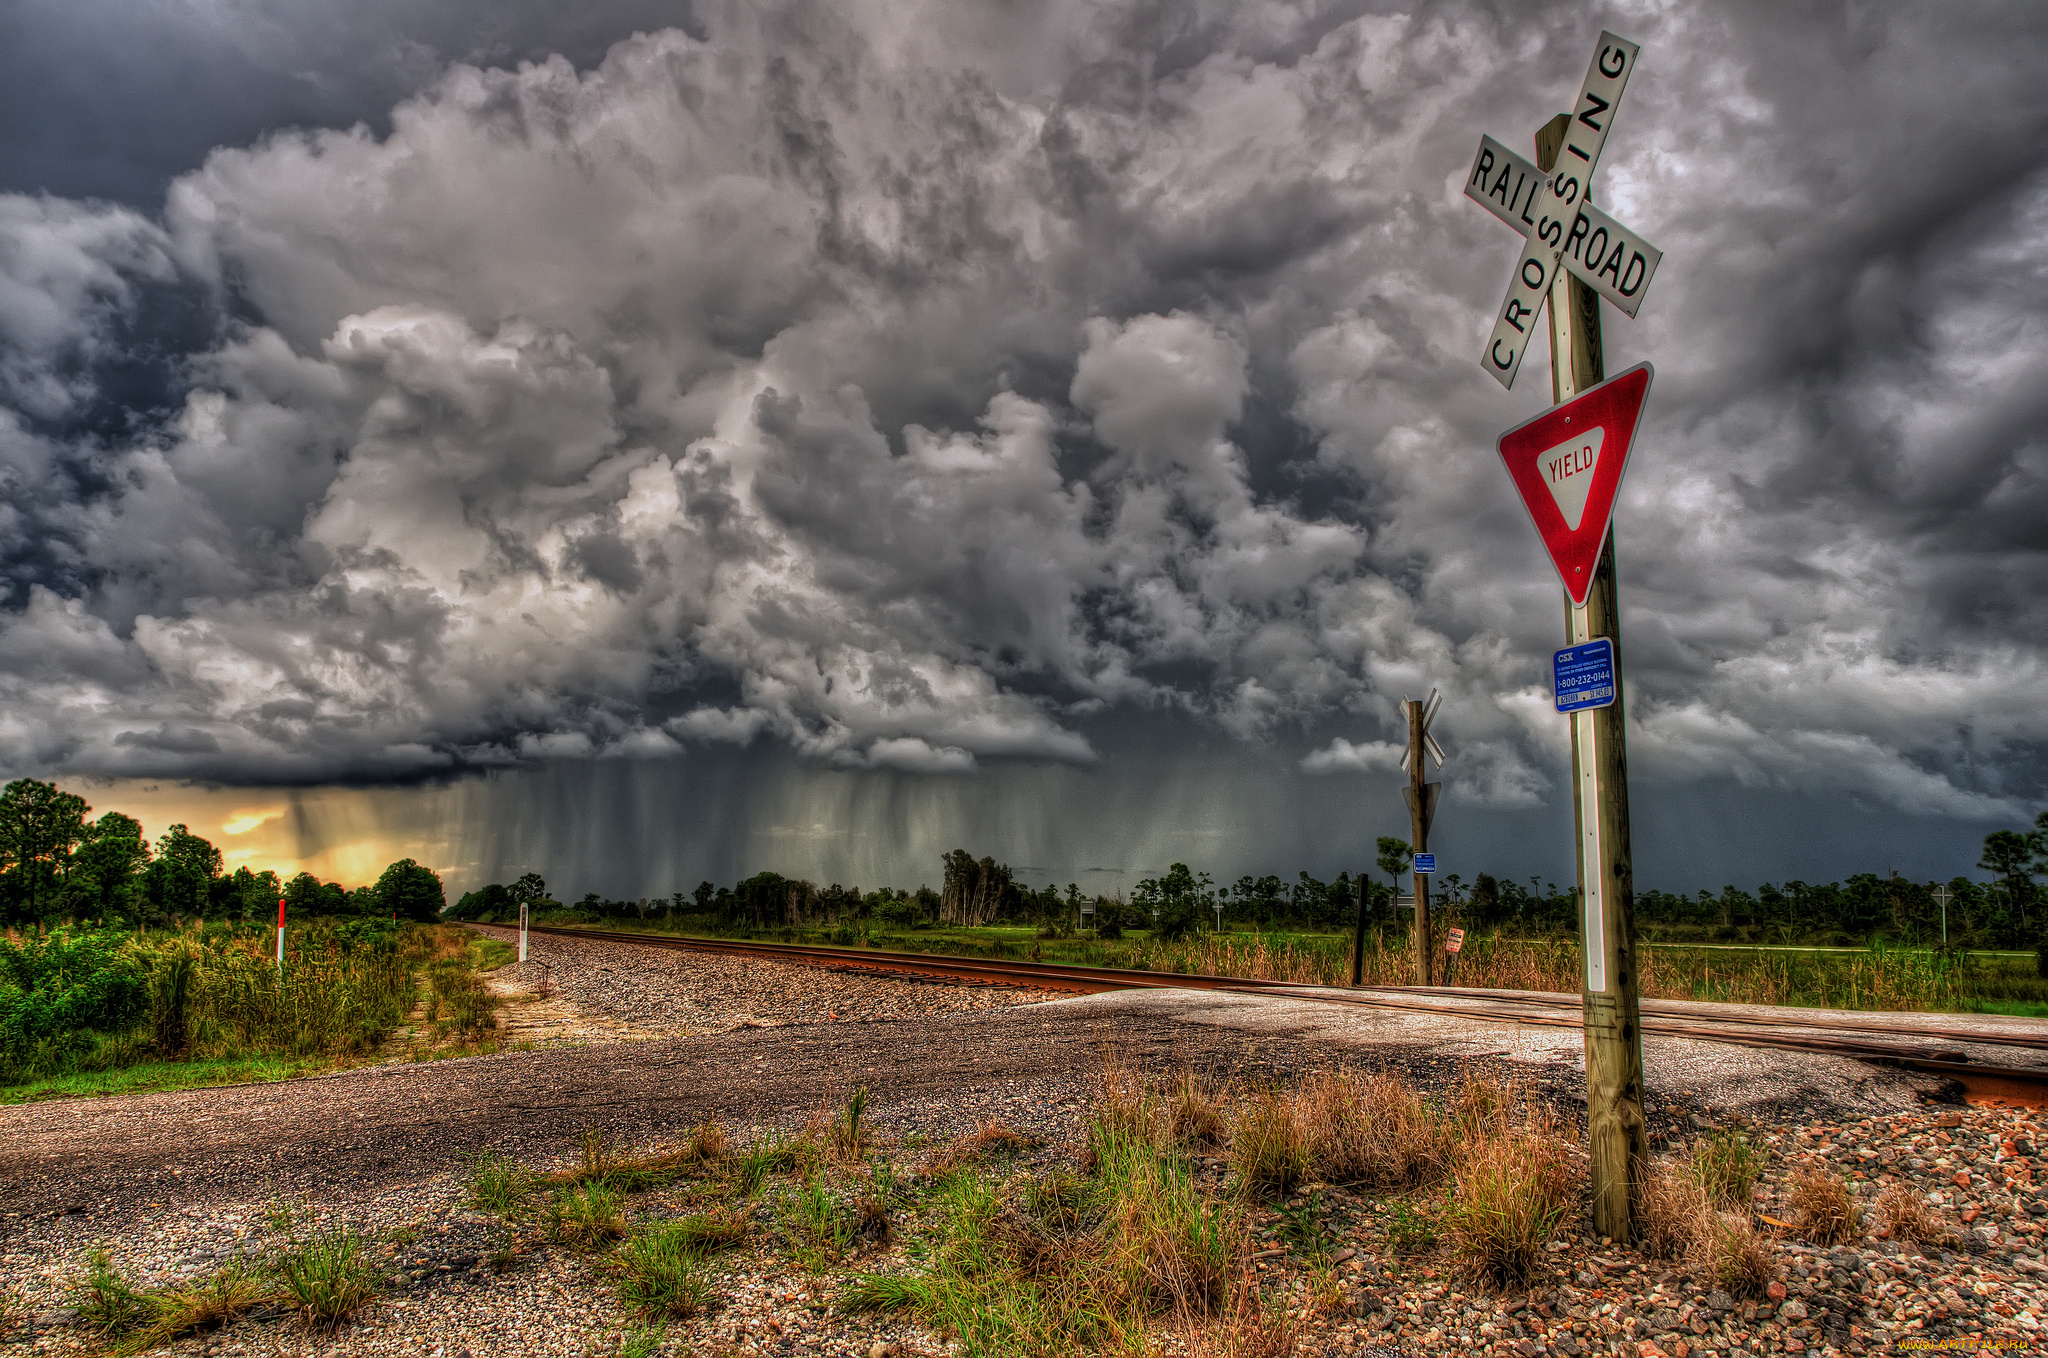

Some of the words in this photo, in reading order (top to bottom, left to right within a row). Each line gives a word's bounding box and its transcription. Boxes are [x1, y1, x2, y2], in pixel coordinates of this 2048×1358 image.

[1472, 147, 1539, 227] RAIL
[1564, 210, 1647, 298] ROAD
[1491, 45, 1626, 371] CROSSING
[1549, 445, 1593, 483] YIELD
[1558, 652, 1573, 663] CSX
[1558, 670, 1610, 689] 1-800-232-0144
